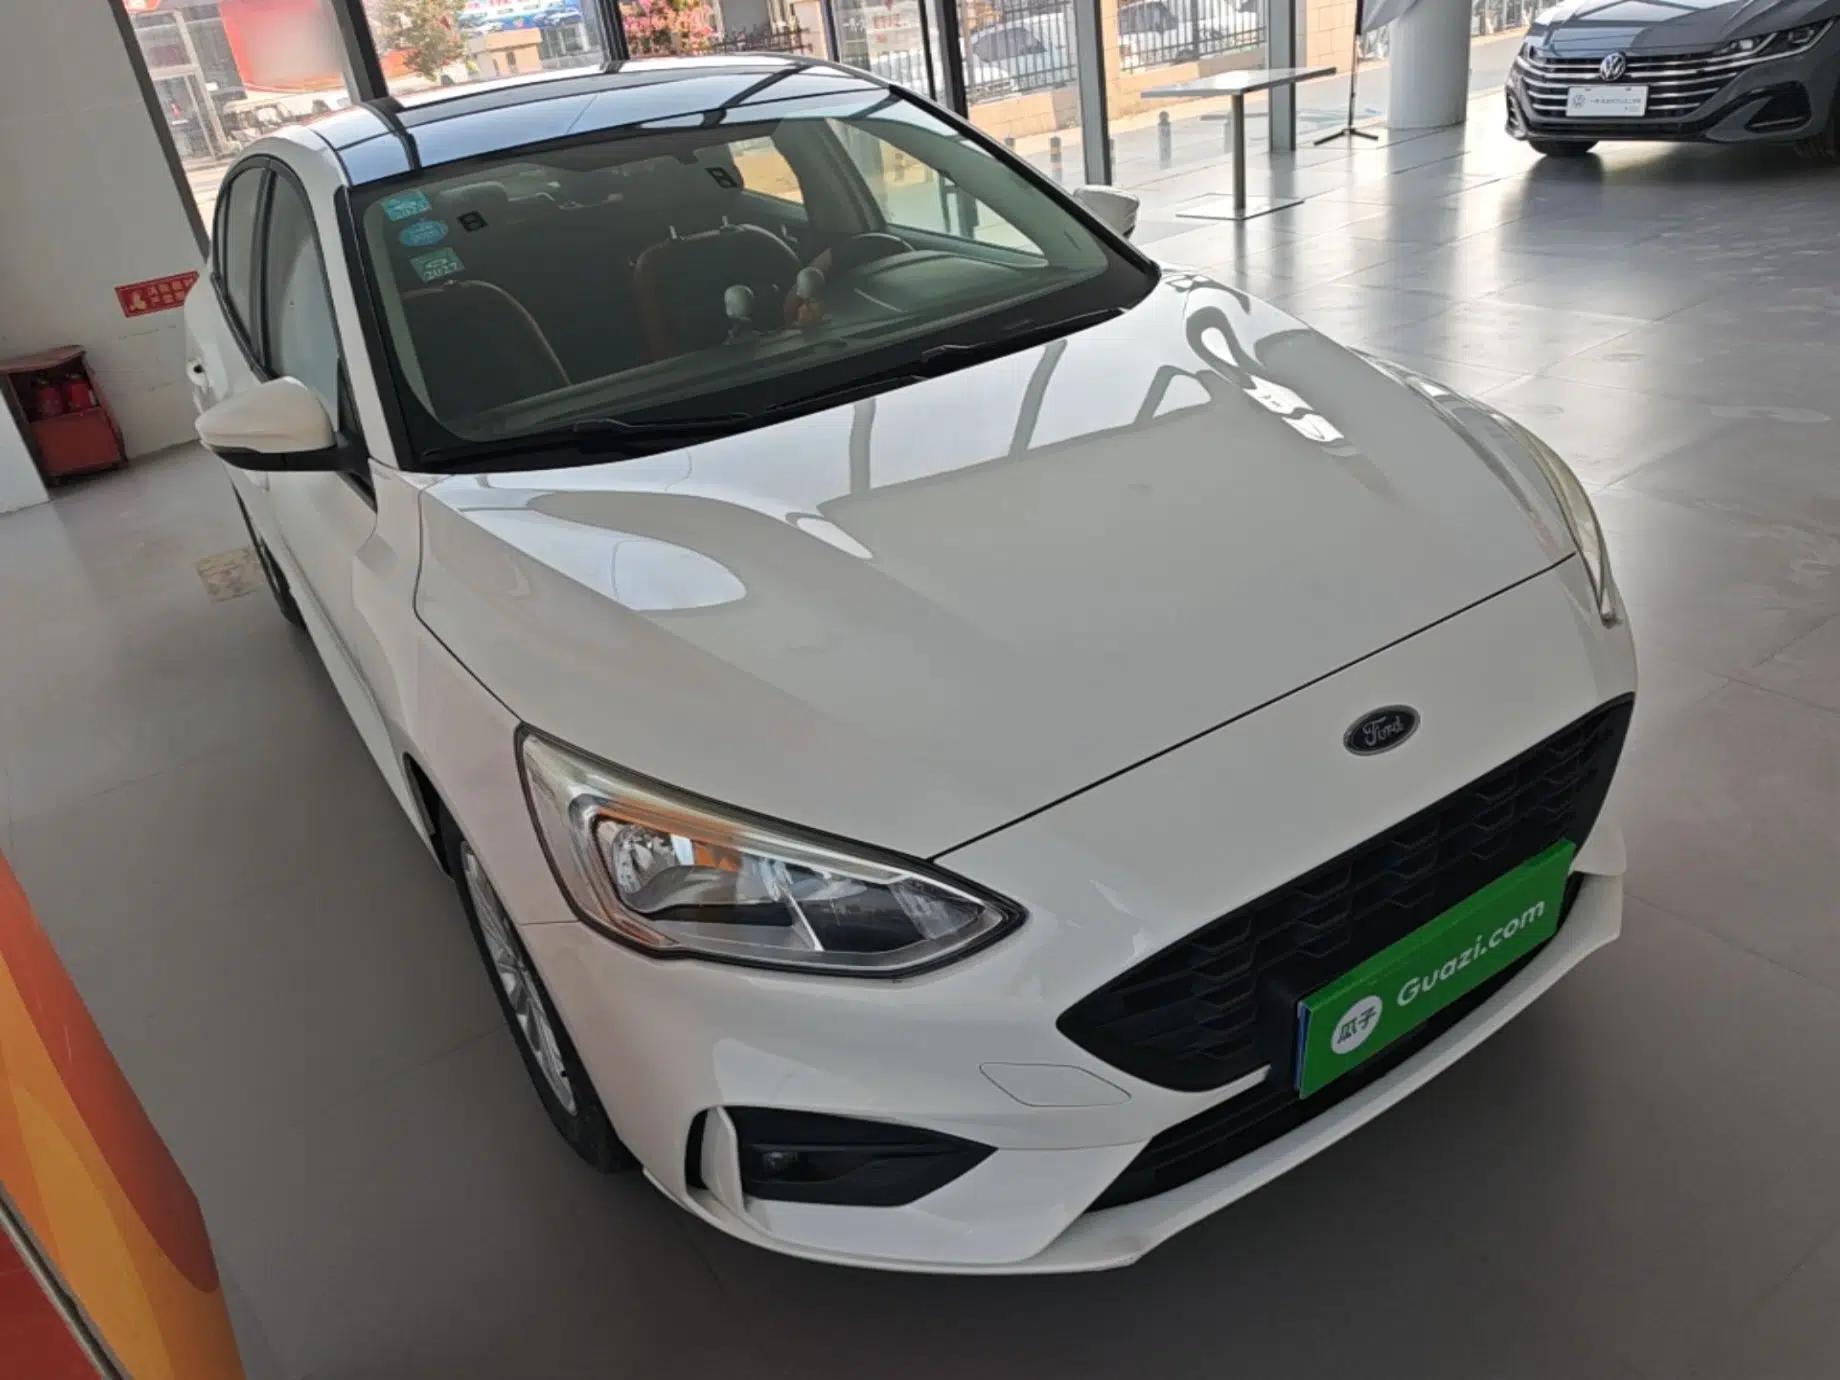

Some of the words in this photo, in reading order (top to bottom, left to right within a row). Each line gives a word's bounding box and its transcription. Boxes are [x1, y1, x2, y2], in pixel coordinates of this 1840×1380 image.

[1362, 715, 1405, 746] Ford
[1397, 900, 1545, 1006] Guazi.com
[1336, 1007, 1377, 1044] 瓜子
